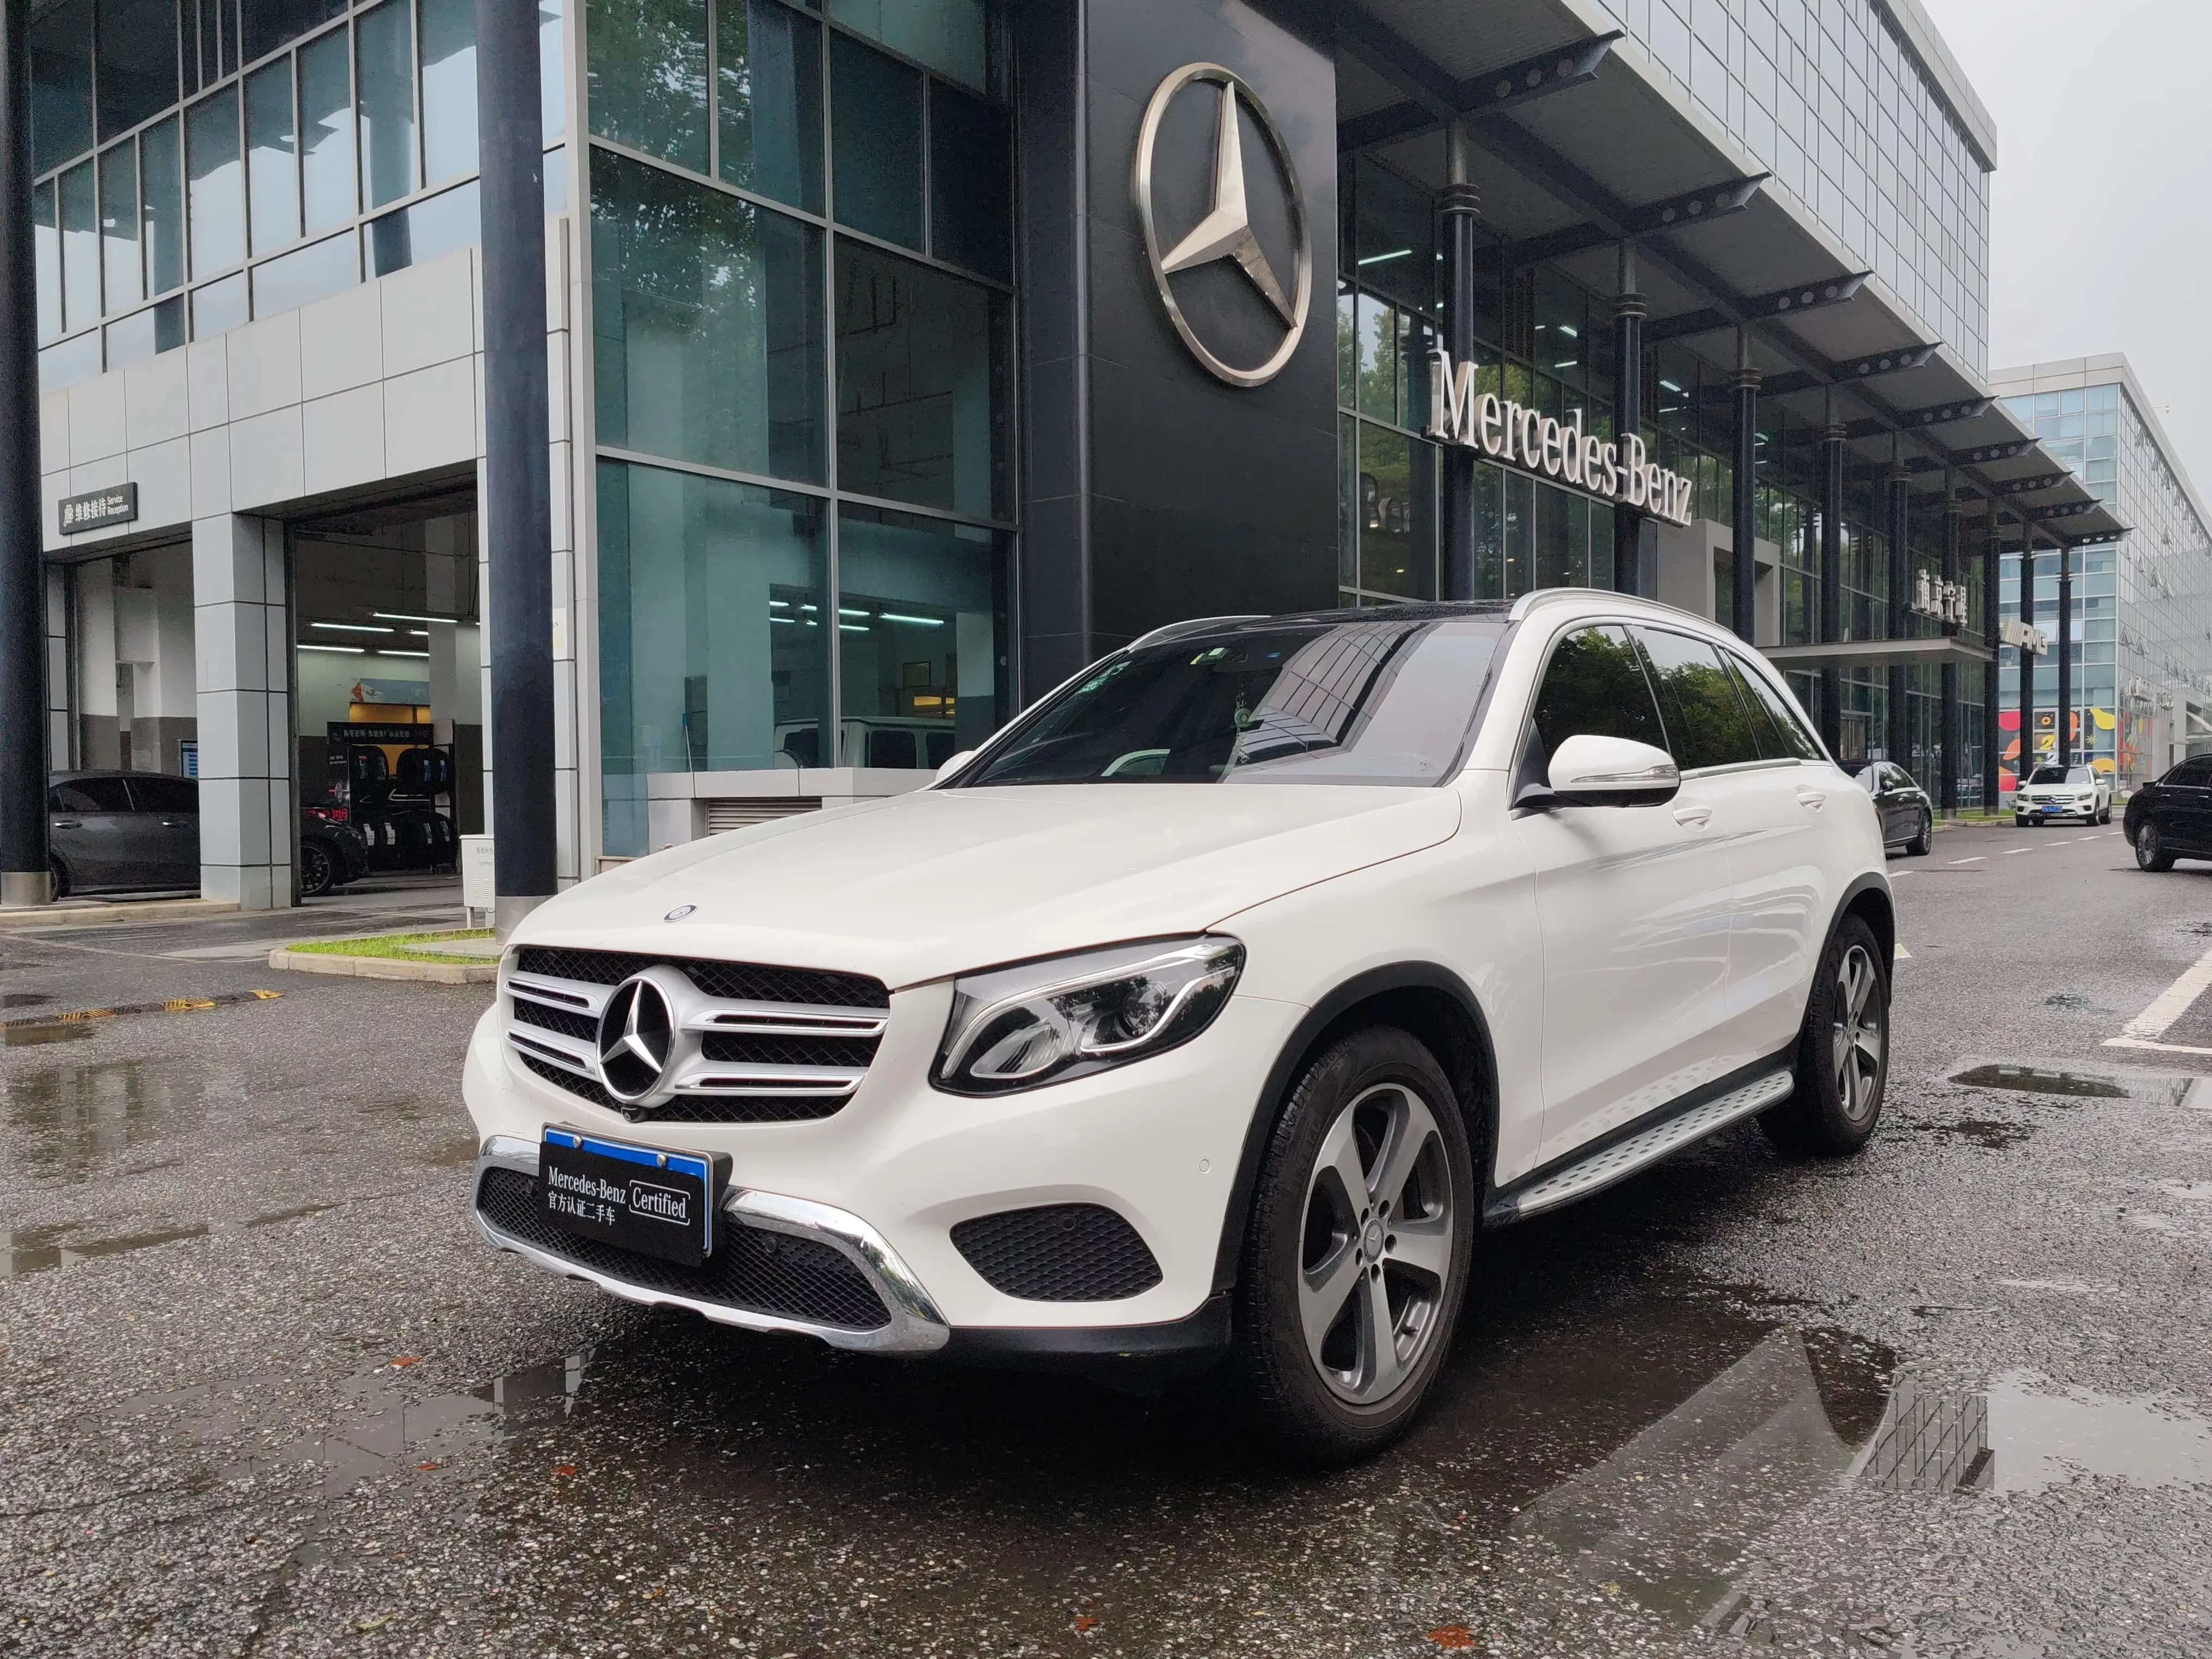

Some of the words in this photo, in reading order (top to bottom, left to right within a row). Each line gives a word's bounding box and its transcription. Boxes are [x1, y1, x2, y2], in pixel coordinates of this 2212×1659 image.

[1428, 348, 1692, 526] Mercedes-Benz
[75, 497, 107, 522] 维修接待
[107, 494, 123, 505] Service
[107, 503, 128, 515] Reception
[2017, 622, 2048, 655] AMG
[548, 1166, 626, 1205] Mercedes-Benz
[632, 1187, 686, 1219] Certified
[548, 1190, 616, 1226] 官方认证二手车
